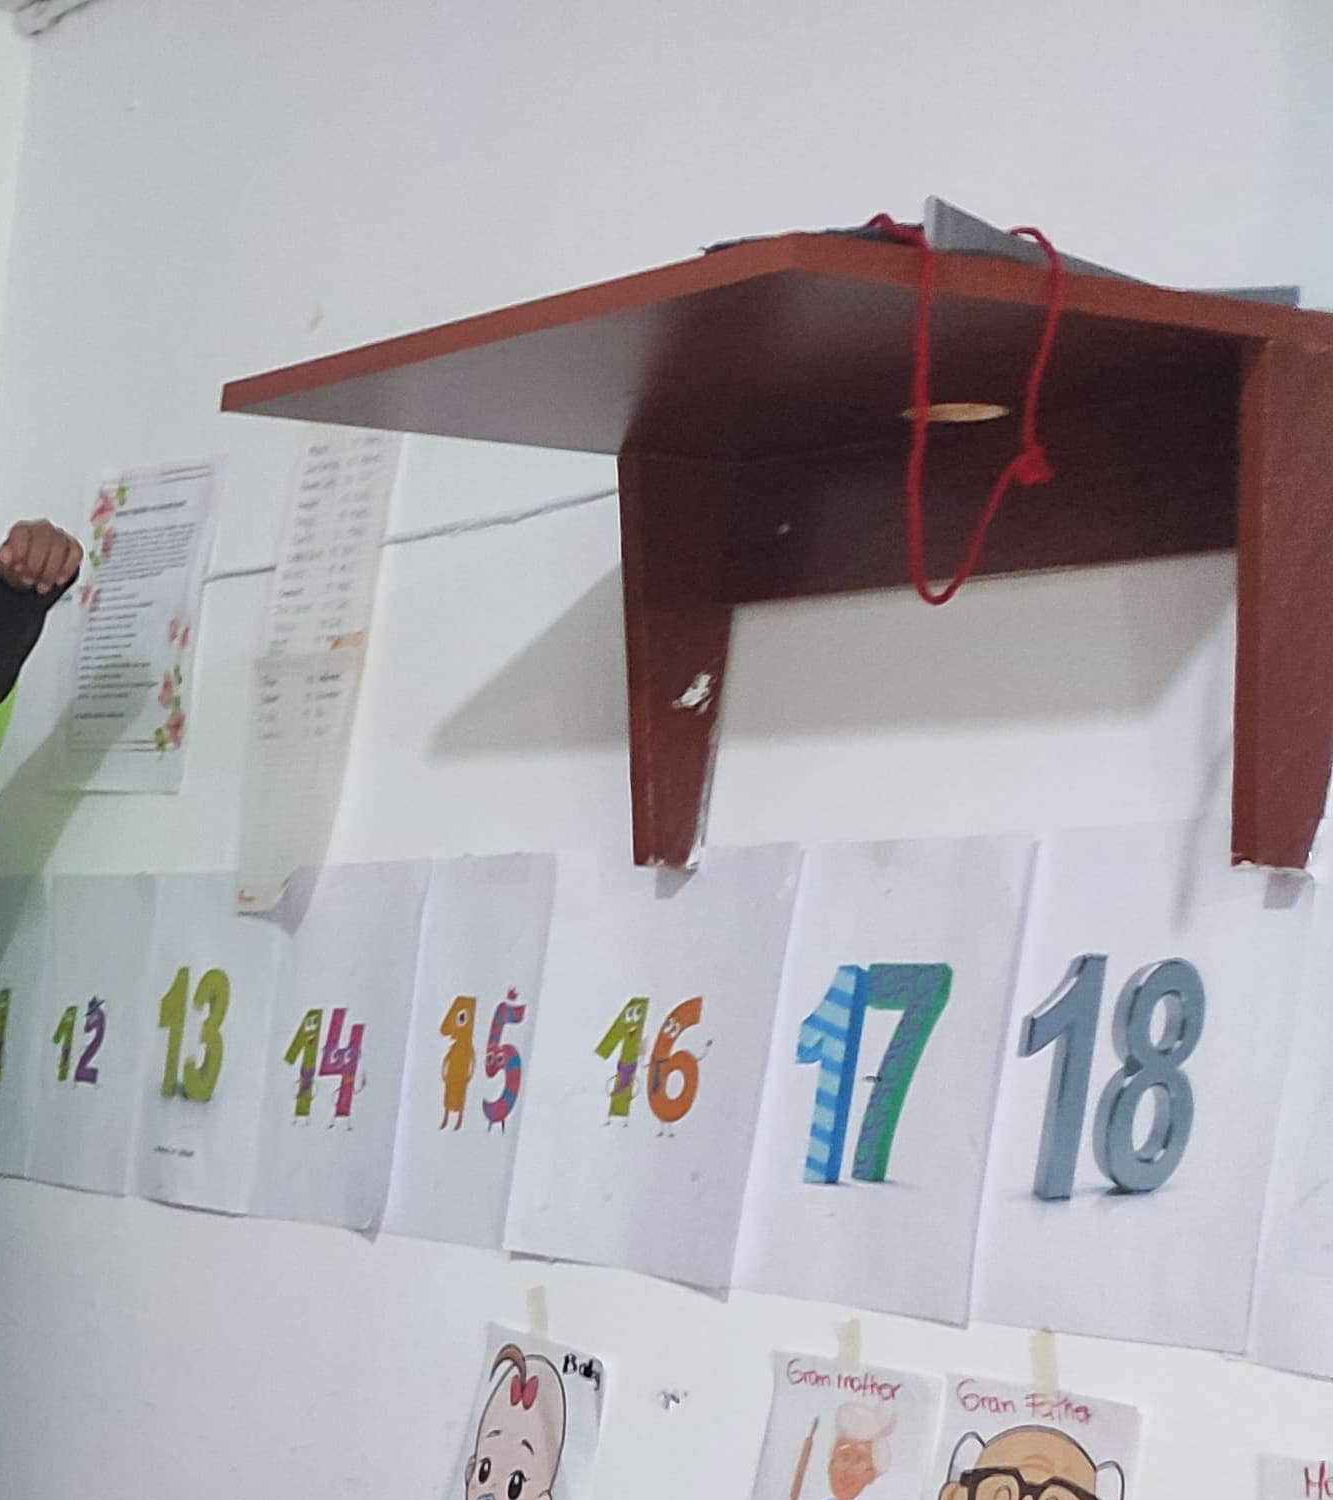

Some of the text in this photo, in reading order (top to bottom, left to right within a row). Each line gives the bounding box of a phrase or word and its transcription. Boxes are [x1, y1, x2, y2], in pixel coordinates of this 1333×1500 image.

[52, 1000, 107, 1084] 12
[159, 966, 231, 1104] 13
[284, 1006, 365, 1119] 14
[440, 993, 527, 1126] 15
[593, 995, 704, 1125] 16
[795, 962, 954, 1185] 17
[1018, 953, 1207, 1202] 18
